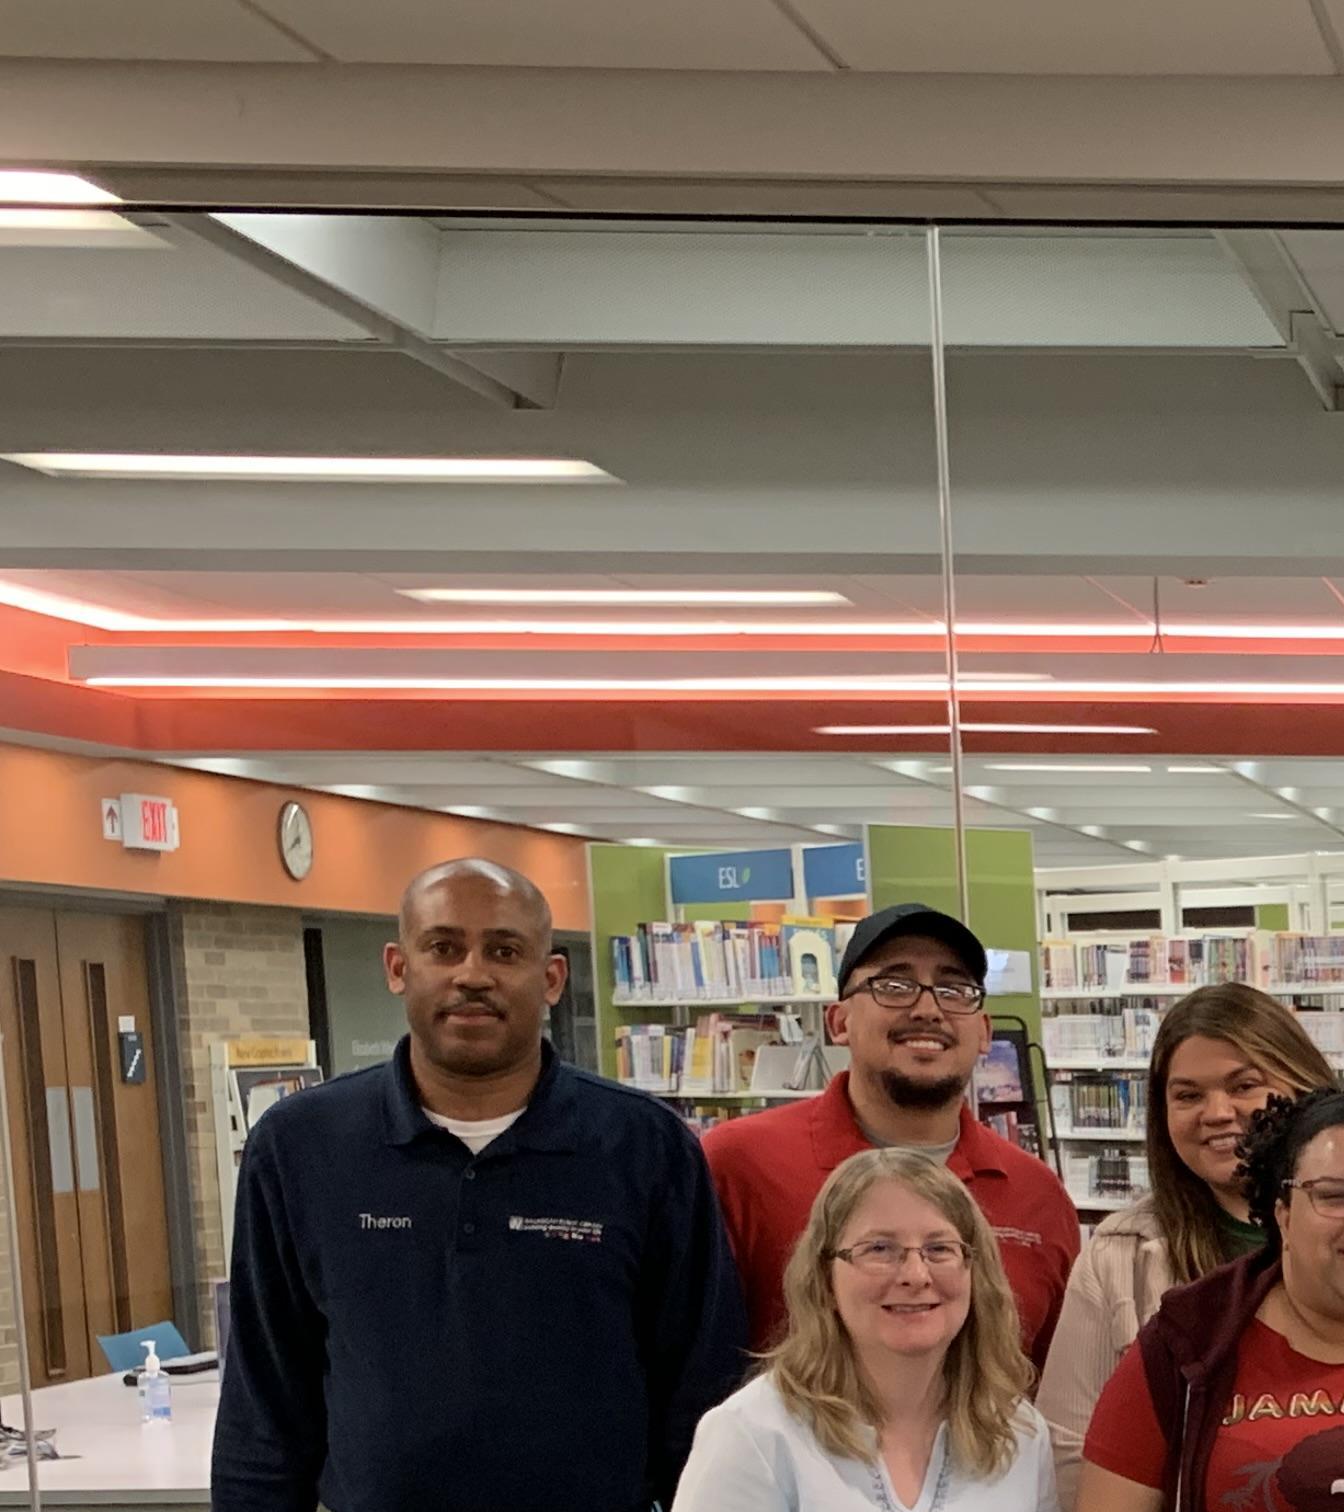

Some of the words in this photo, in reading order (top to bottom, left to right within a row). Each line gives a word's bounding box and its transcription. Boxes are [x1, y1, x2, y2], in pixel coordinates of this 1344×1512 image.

[142, 800, 167, 843] EXIT
[718, 867, 740, 889] ESL
[358, 1213, 412, 1229] Theron
